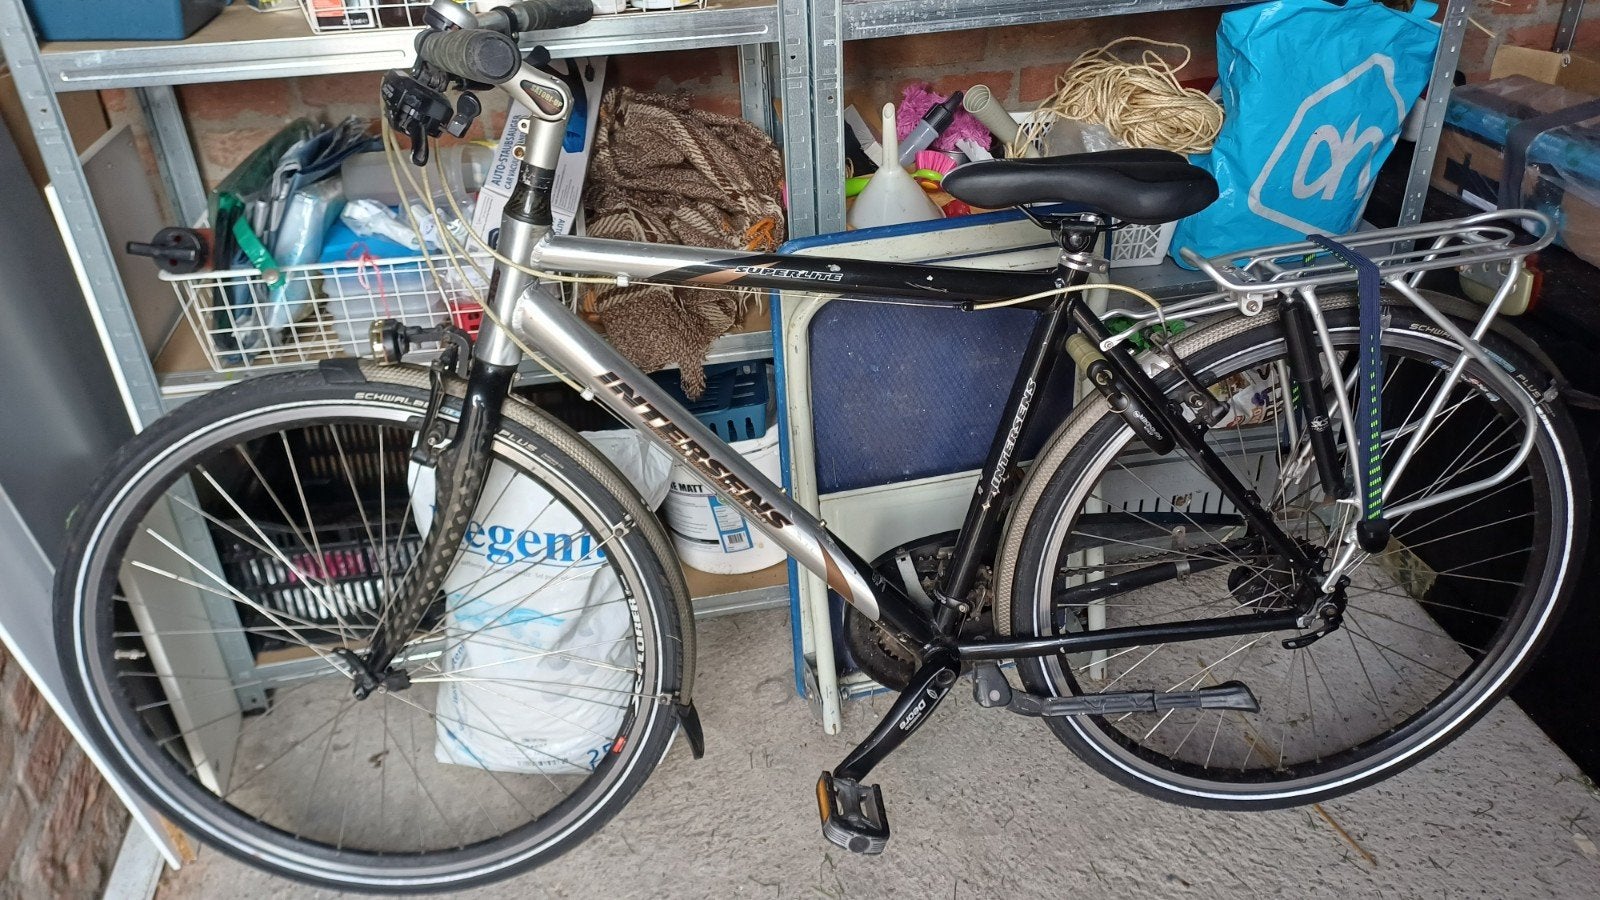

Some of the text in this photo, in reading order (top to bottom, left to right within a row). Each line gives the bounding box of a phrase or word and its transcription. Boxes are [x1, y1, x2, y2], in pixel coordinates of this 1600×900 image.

[735, 265, 844, 282] SUPERLITE
[1515, 373, 1542, 399] PLUS
[499, 429, 539, 452] PLUS
[991, 377, 1036, 489] INTERSENS
[594, 371, 794, 529] INTERSENS
[678, 483, 704, 493] MATT
[899, 699, 927, 730] Deore
